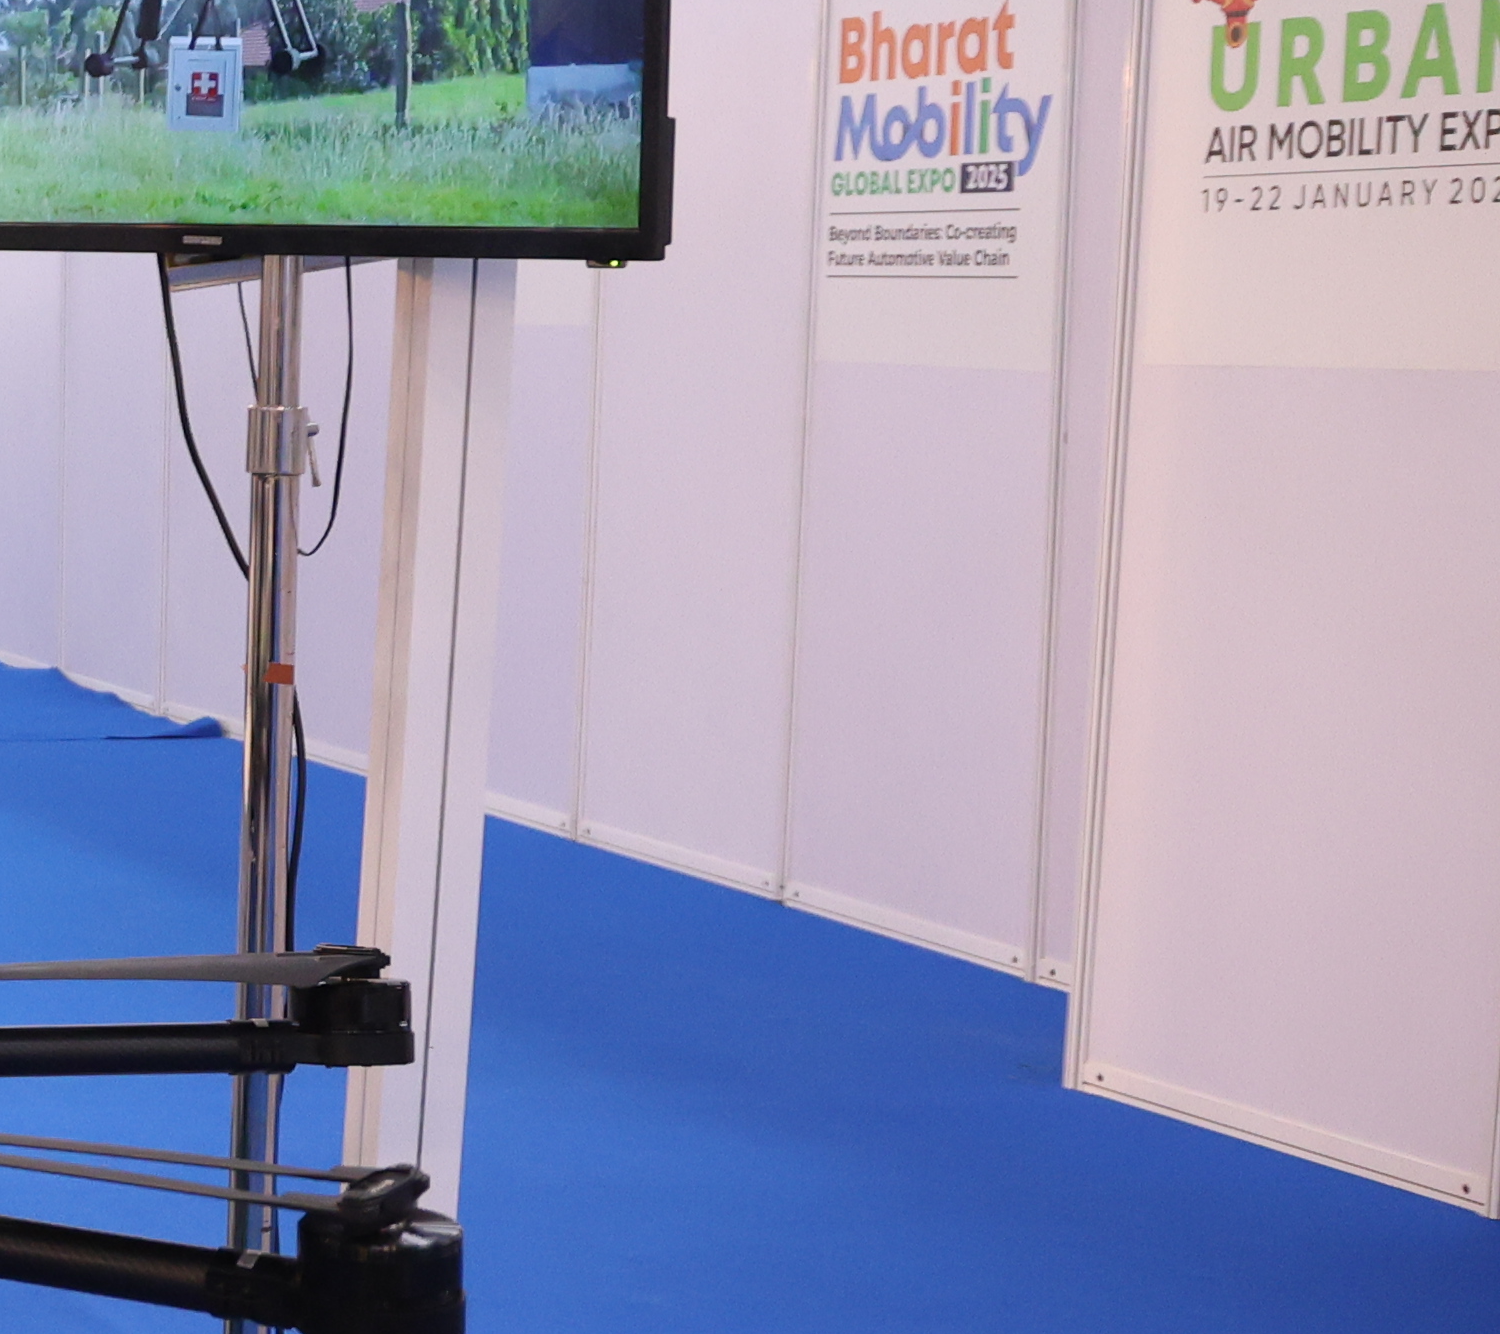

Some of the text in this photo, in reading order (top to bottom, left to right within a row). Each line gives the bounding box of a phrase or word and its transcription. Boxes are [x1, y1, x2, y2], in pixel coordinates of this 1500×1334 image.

[833, 76, 1054, 178] Mobility
[1204, 124, 1257, 165] AIR
[1267, 112, 1430, 161] MOBILITY
[830, 164, 1009, 196] GLOBAL EXPO 2025
[1201, 185, 1282, 213] 19-22
[1292, 178, 1439, 211] JANUARY
[828, 225, 871, 245] Beyond
[828, 250, 865, 267] Future
[867, 249, 934, 267] Automotive
[974, 248, 1010, 266] Chain
